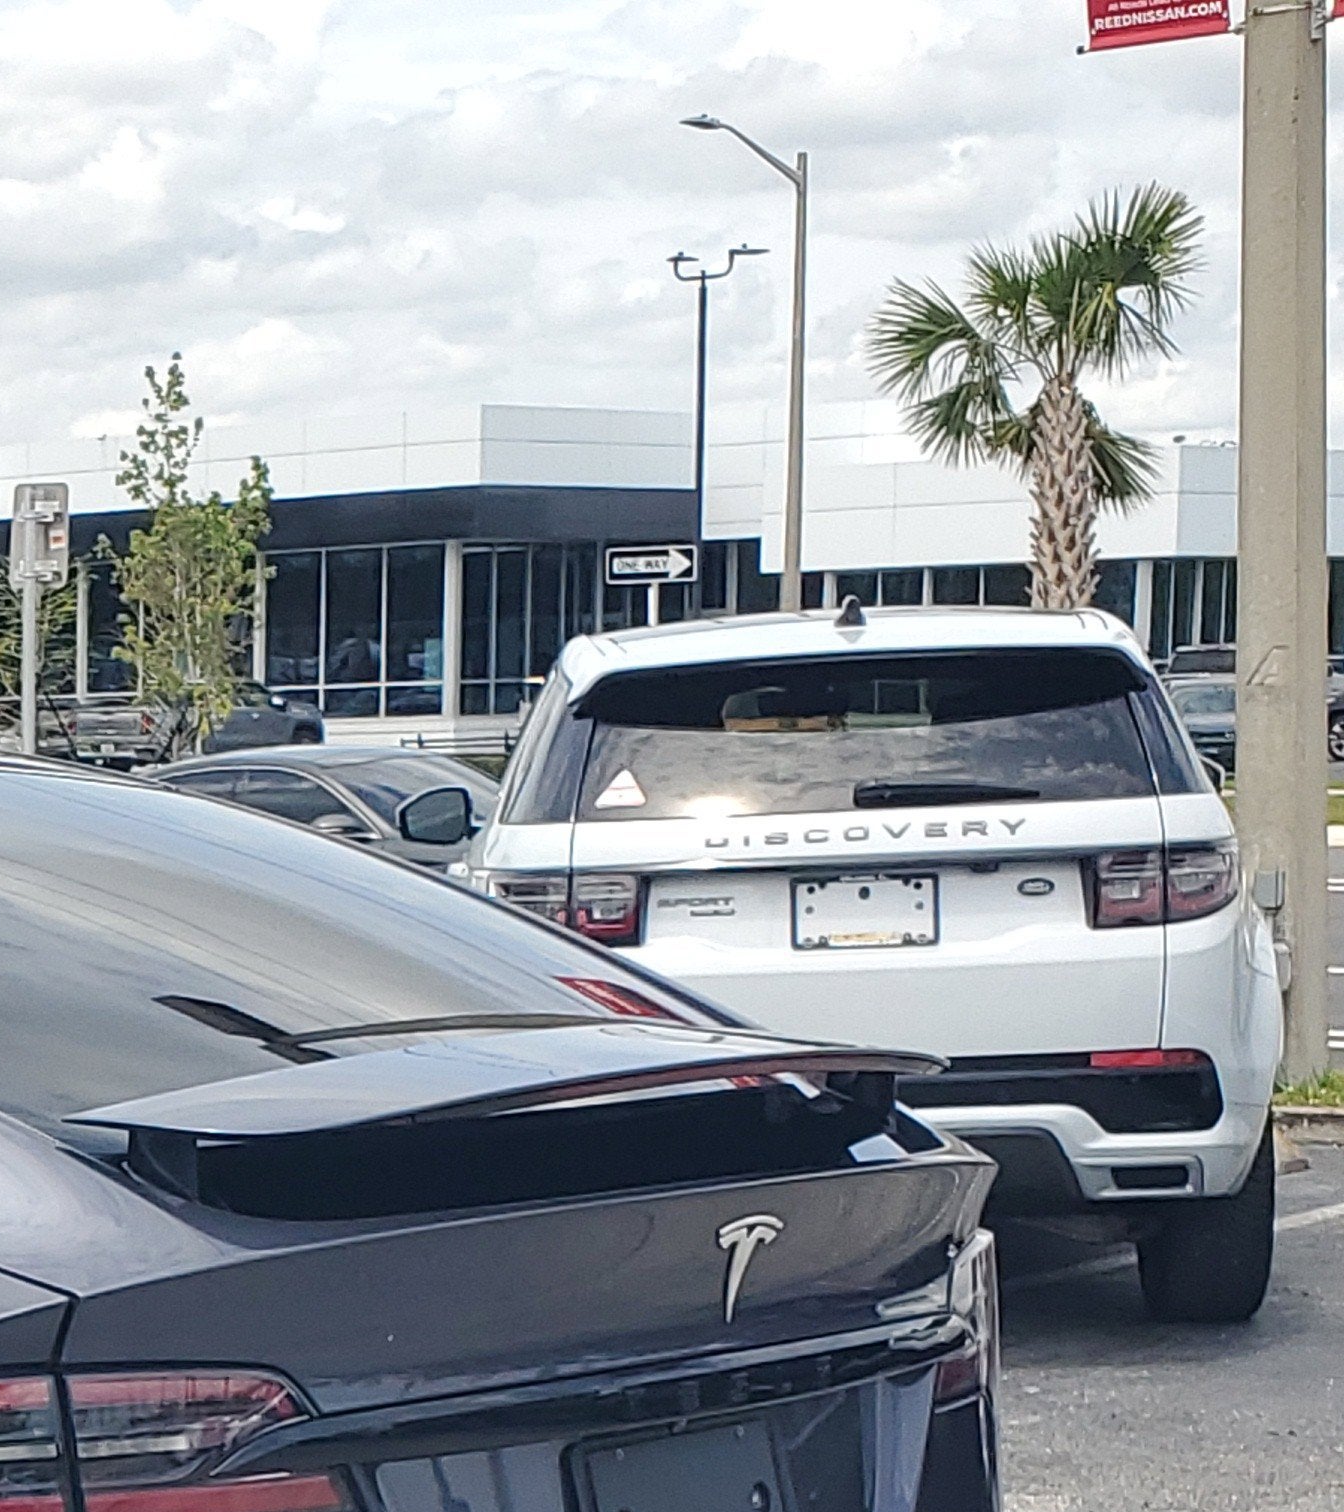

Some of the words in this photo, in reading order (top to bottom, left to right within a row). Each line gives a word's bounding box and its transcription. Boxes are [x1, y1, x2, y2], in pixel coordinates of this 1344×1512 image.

[1094, 1, 1223, 30] REEDNISSAN.COM
[616, 560, 642, 572] ONE
[644, 559, 669, 570] WAY
[705, 818, 1026, 848] DISCOVERY
